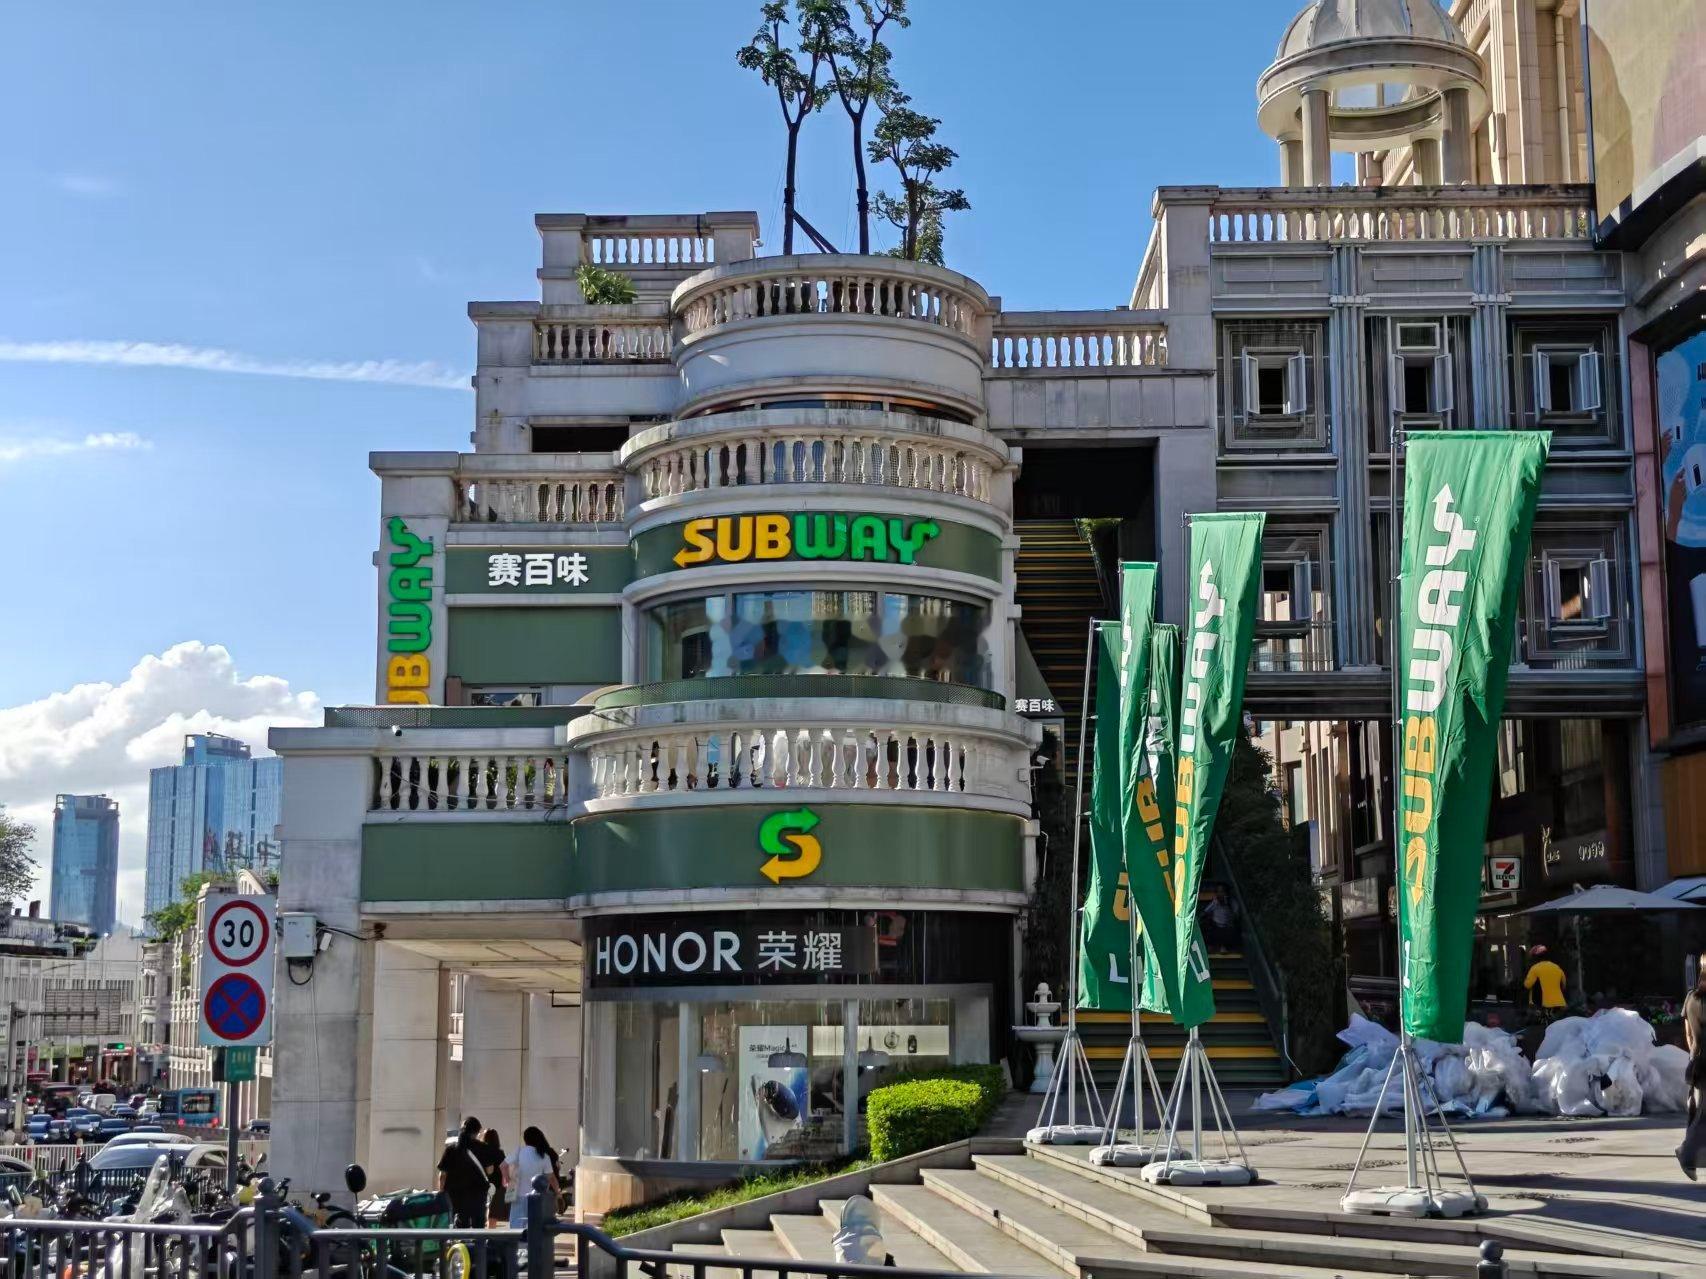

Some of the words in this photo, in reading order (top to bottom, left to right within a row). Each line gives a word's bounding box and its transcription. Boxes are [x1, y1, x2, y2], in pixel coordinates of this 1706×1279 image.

[672, 513, 941, 568] SUBWAY
[488, 553, 590, 587] 赛百味
[1014, 698, 1055, 712] 赛百味
[1403, 483, 1477, 908] SUBWAY
[1495, 862, 1515, 888] 7
[221, 919, 255, 948] 30
[596, 931, 743, 975] HONOR
[757, 930, 842, 971] 荣耀
